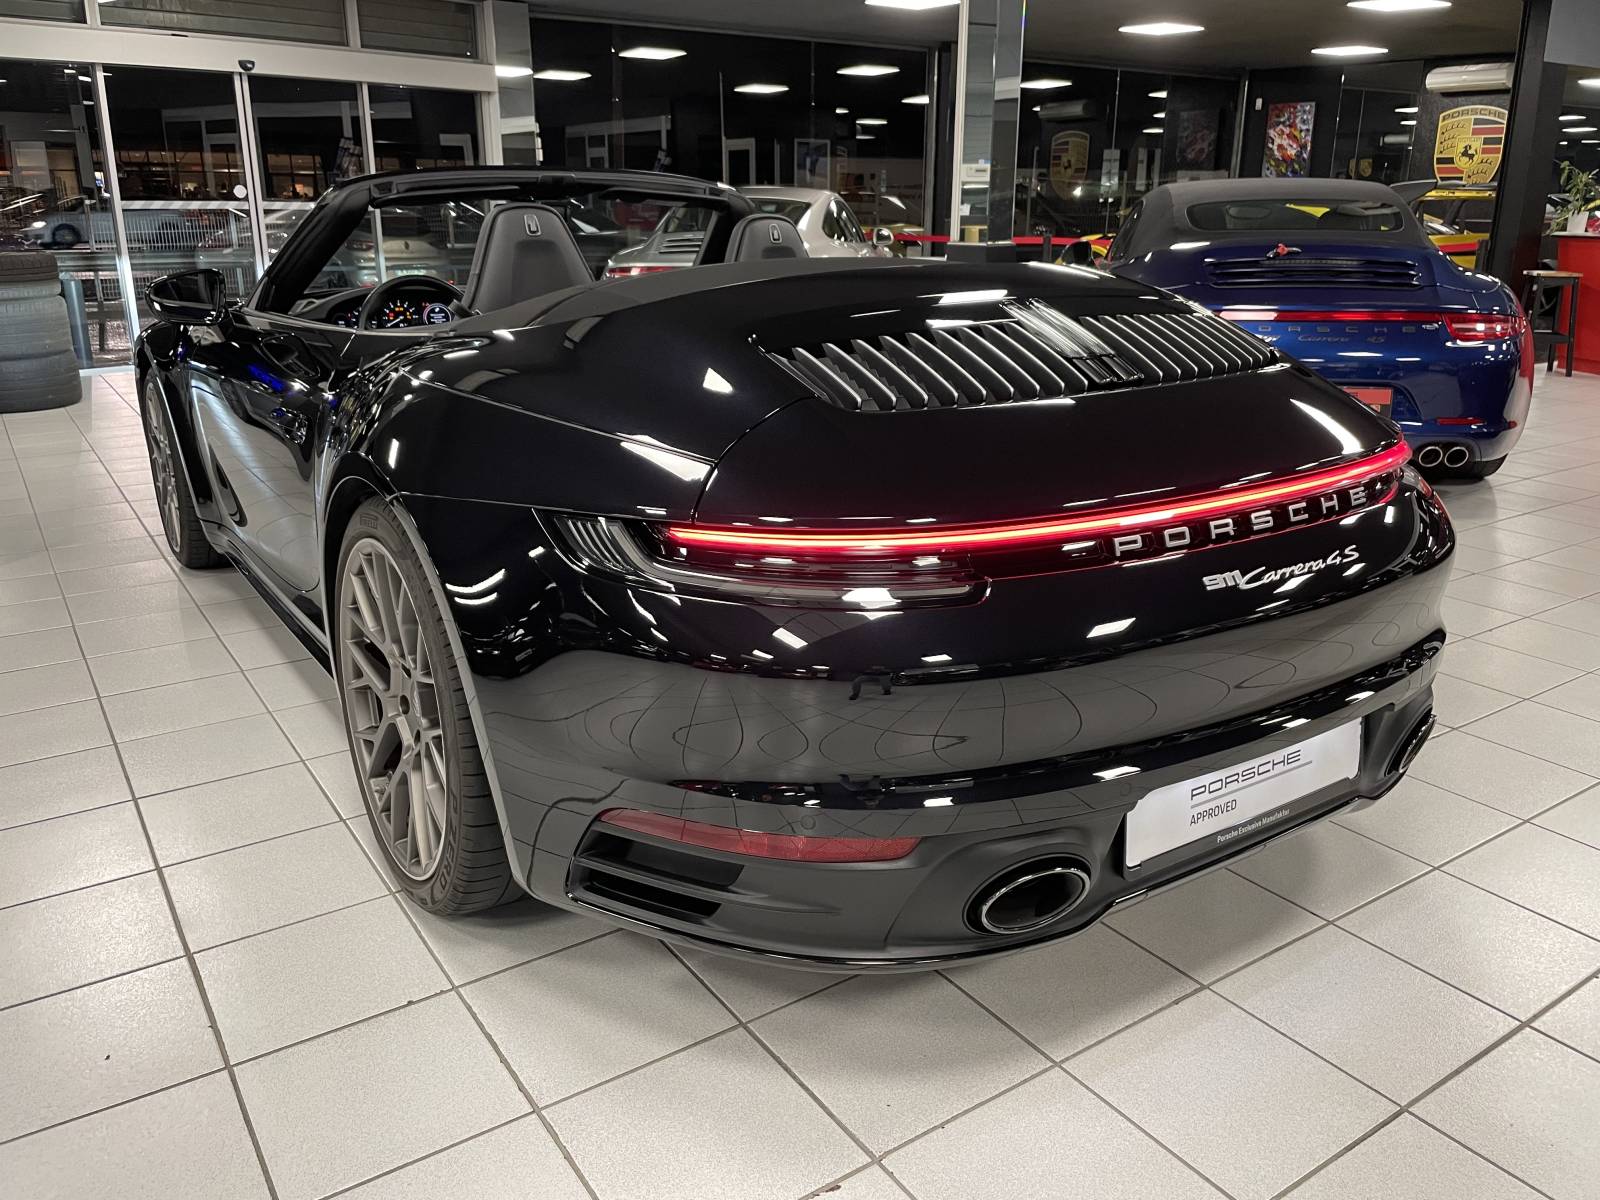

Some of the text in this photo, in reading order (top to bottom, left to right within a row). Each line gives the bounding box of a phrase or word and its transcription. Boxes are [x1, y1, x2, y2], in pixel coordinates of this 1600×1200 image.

[1441, 107, 1507, 123] PORSCHE
[1258, 325, 1416, 334] ORSCHE
[1113, 486, 1367, 557] PORSCHE
[1190, 749, 1302, 801] PORSCHE
[1189, 799, 1237, 827] APPROVED
[1216, 808, 1290, 844] Porsche Exclusive Manufaktur
